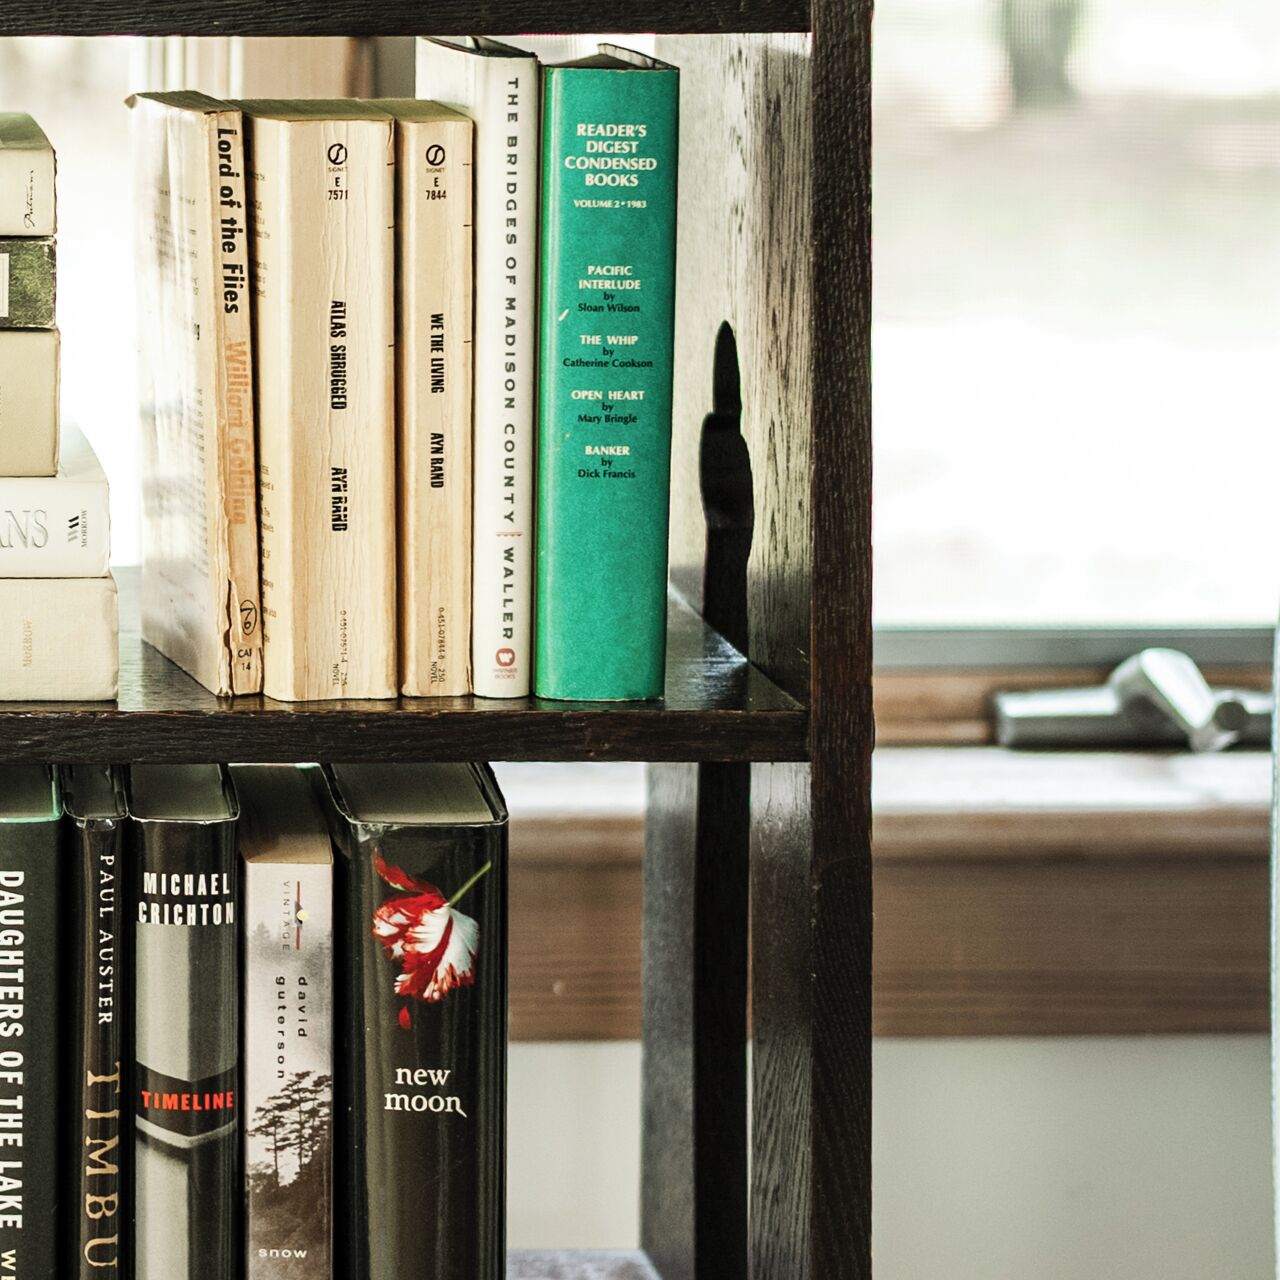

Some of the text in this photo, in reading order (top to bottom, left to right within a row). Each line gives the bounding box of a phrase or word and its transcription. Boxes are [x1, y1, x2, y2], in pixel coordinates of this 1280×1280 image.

[586, 141, 639, 154] DIGEST
[564, 156, 657, 171] CONDENSED
[585, 173, 639, 187] BOOKS
[587, 265, 633, 276] PACIFIC
[578, 279, 641, 290] INTERLUDE
[578, 303, 640, 312] Sloan Wilson
[580, 335, 639, 345] THE WHIP
[330, 299, 347, 410] ATLAS SHRUGGED
[502, 77, 519, 640] THE BRIDGES OF MADISON COUNTY WALLER
[562, 357, 653, 368] Catherine Cookson
[570, 390, 645, 400] OPEN HEART
[577, 413, 638, 425] Mary Bringle
[584, 445, 630, 456] BANKER
[431, 432, 444, 489] AYN RAND
[577, 469, 636, 479] Dick Francis
[142, 871, 231, 896] MICHAEL
[138, 901, 235, 926] CRICHTON
[98, 854, 115, 1025] PAUL AUSTER
[297, 975, 308, 1038] david
[275, 975, 286, 1079] guterson
[395, 1066, 451, 1087] new
[141, 1090, 234, 1111] TIMELINE
[384, 1090, 468, 1119] moon
[258, 1247, 308, 1259] snow
